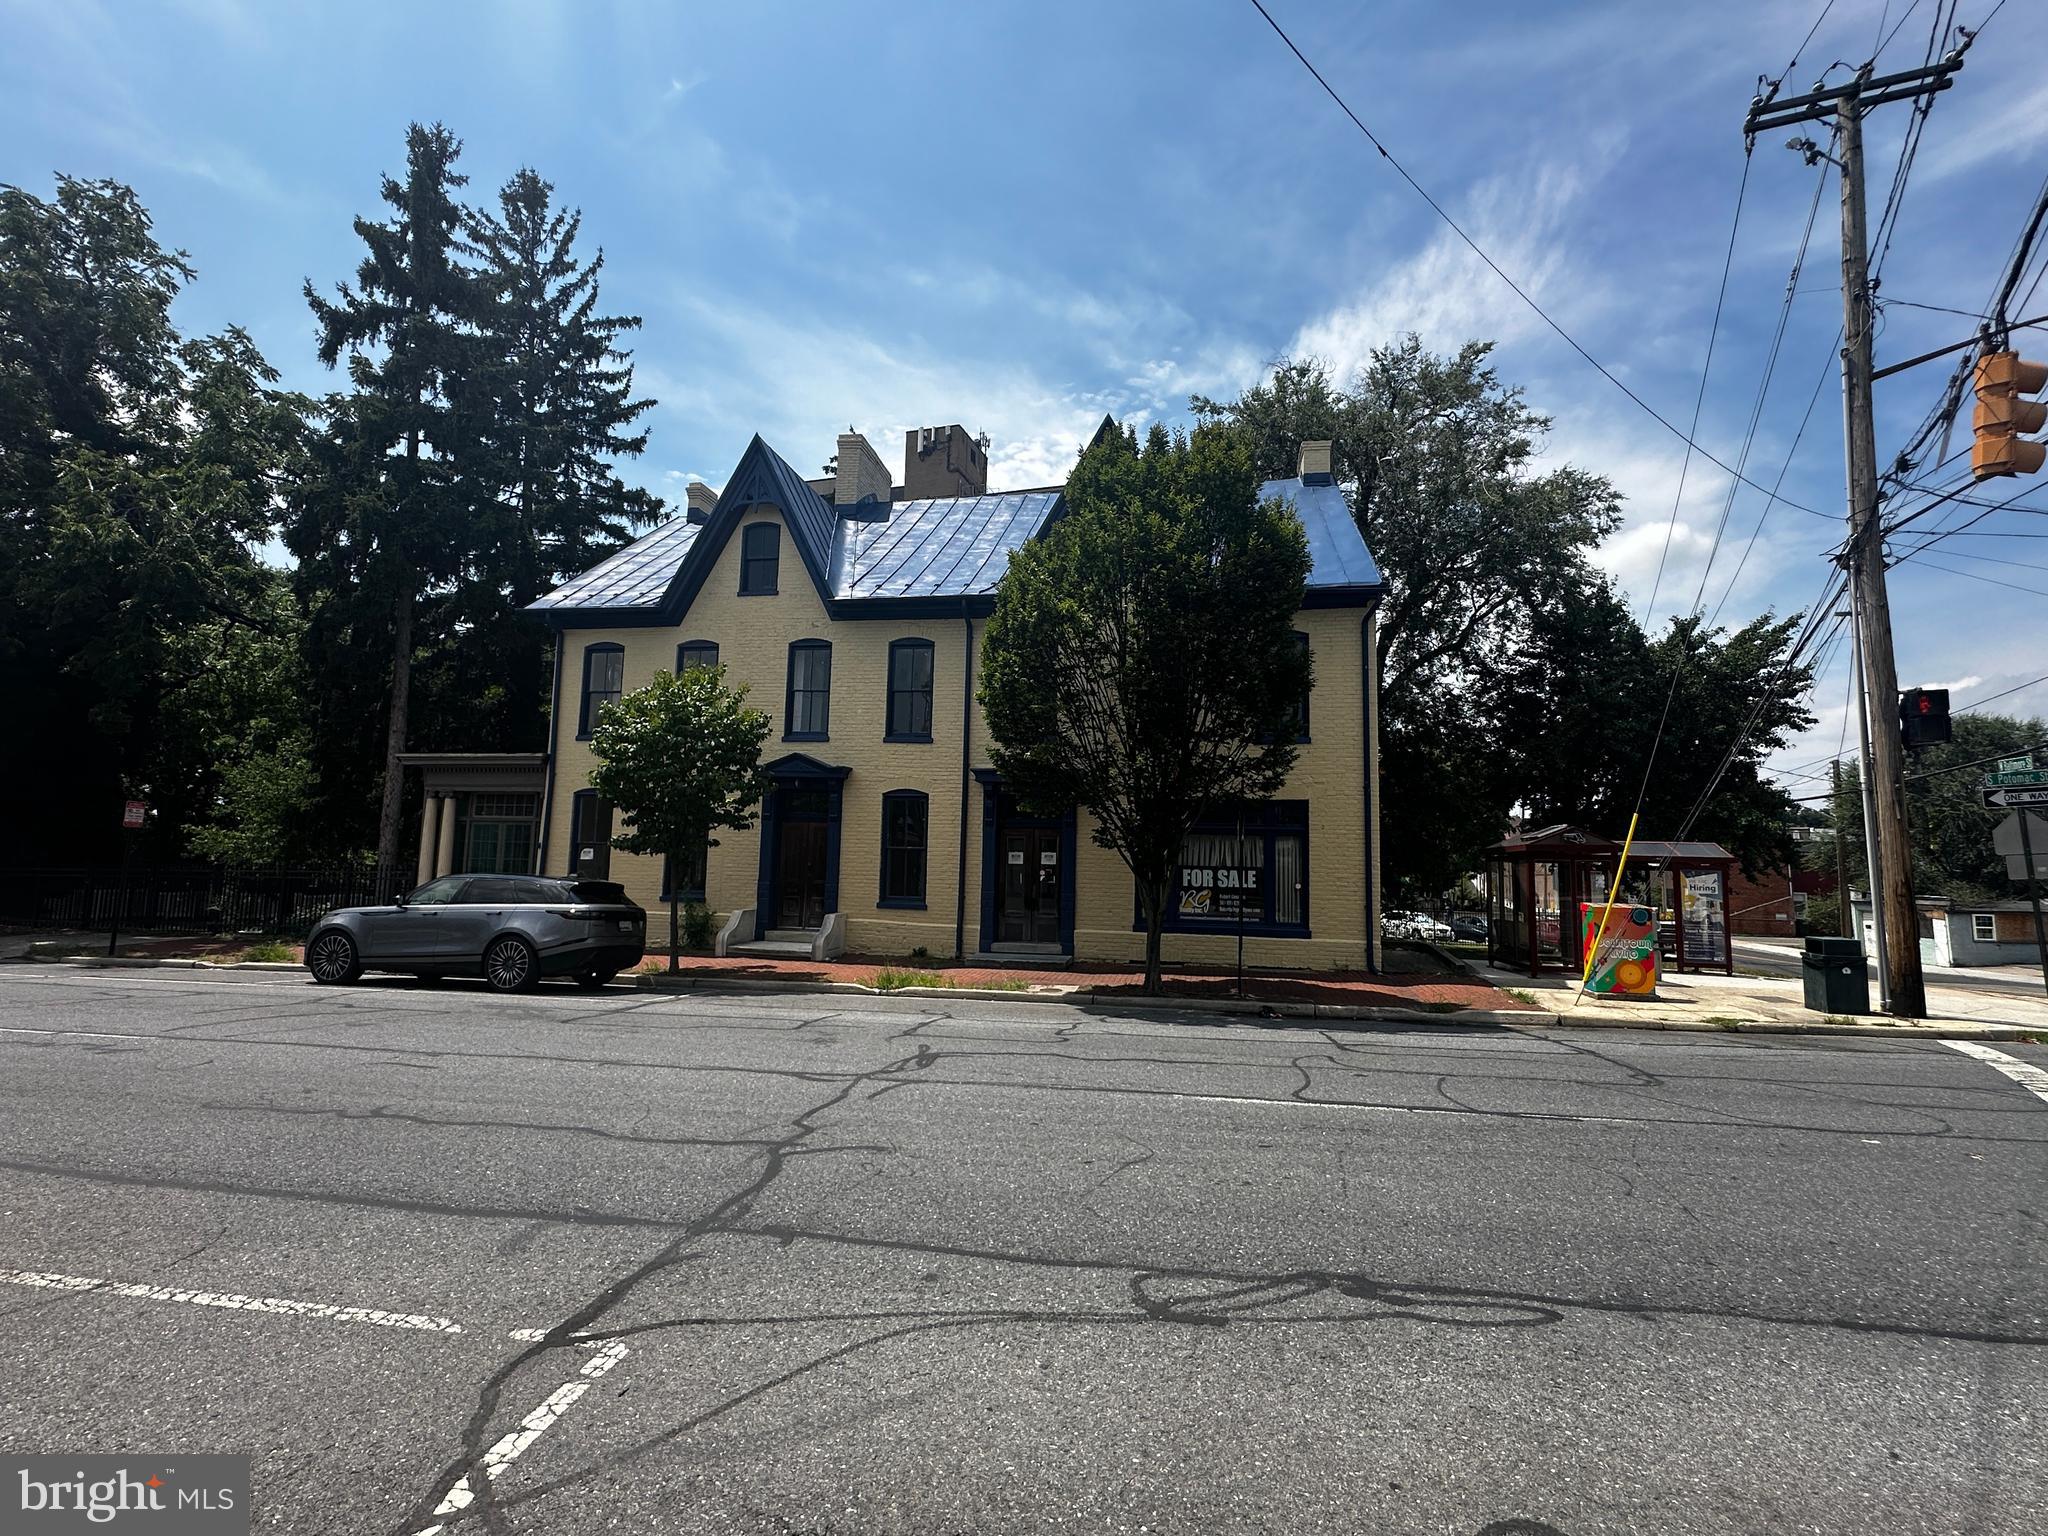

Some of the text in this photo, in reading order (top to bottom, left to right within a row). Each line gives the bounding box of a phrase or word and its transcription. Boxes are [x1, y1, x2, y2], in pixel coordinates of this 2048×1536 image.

[1987, 771, 2048, 785] S Potomac St
[2004, 791, 2048, 801] ONE WAY
[1182, 868, 1257, 888] FOR SALE
[1689, 883, 1716, 893] Hiring
